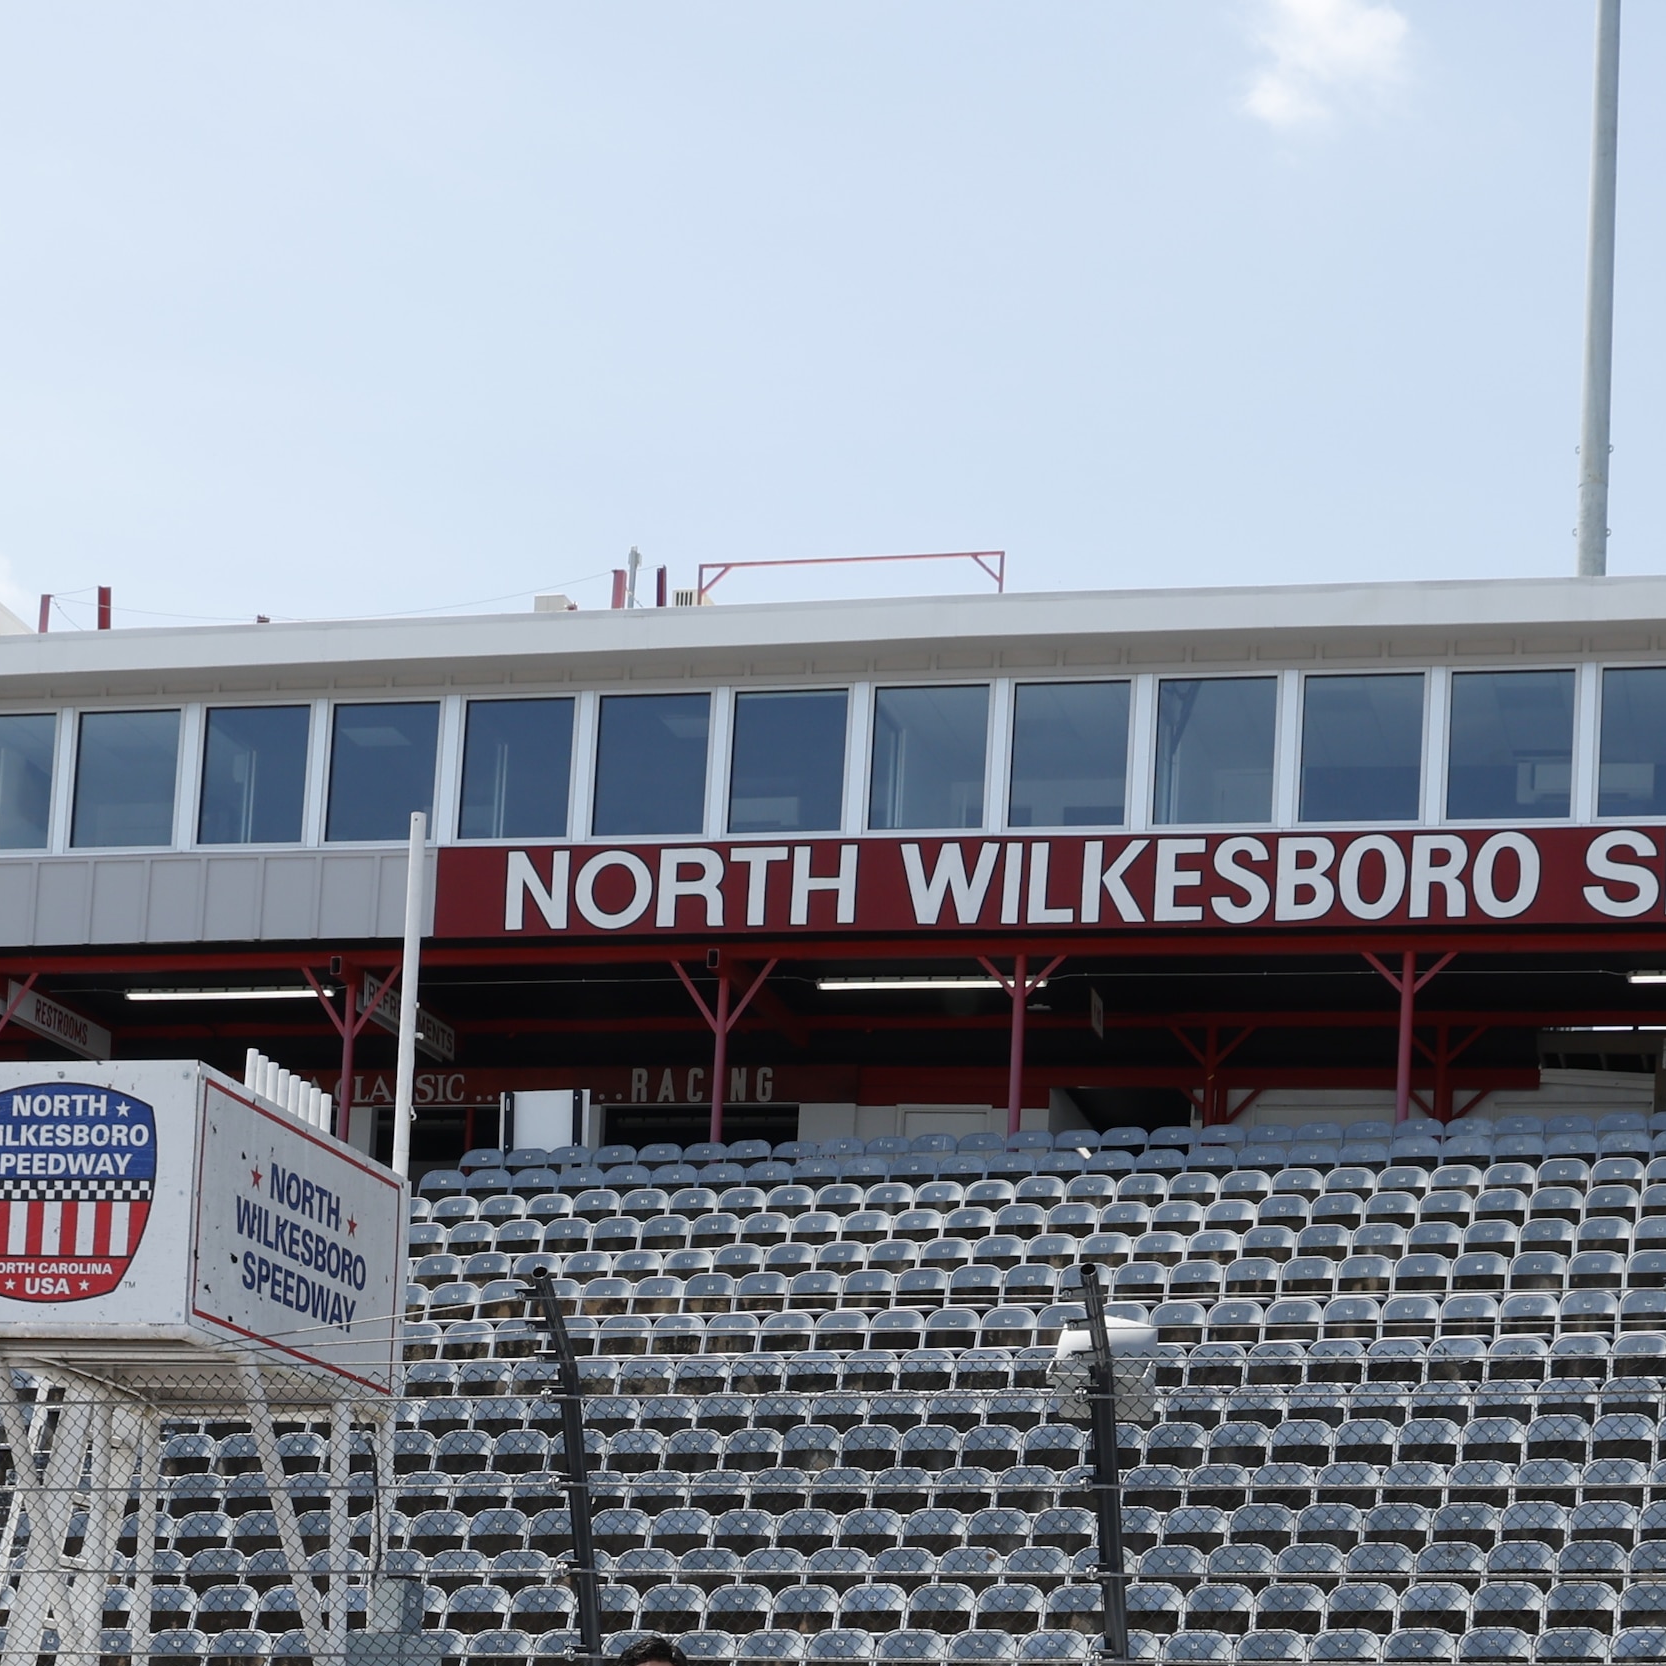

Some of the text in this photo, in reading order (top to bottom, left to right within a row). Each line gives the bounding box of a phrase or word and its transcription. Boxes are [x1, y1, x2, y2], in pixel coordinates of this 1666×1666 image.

[504, 843, 859, 932] NORTH
[900, 831, 1540, 926] WILKESBORO
[34, 998, 89, 1046] RESTROOMS
[368, 981, 453, 1054] REFRMENTS
[11, 1094, 108, 1117] NORTH
[334, 1074, 465, 1104] CLASIC
[631, 1067, 774, 1103] RACNG
[269, 1161, 342, 1232] NORTH
[236, 1194, 367, 1292] WILKESBORO
[24, 1277, 71, 1295] USA
[38, 1262, 113, 1275] CAROLINA
[242, 1250, 357, 1334] SPEEDWAY
